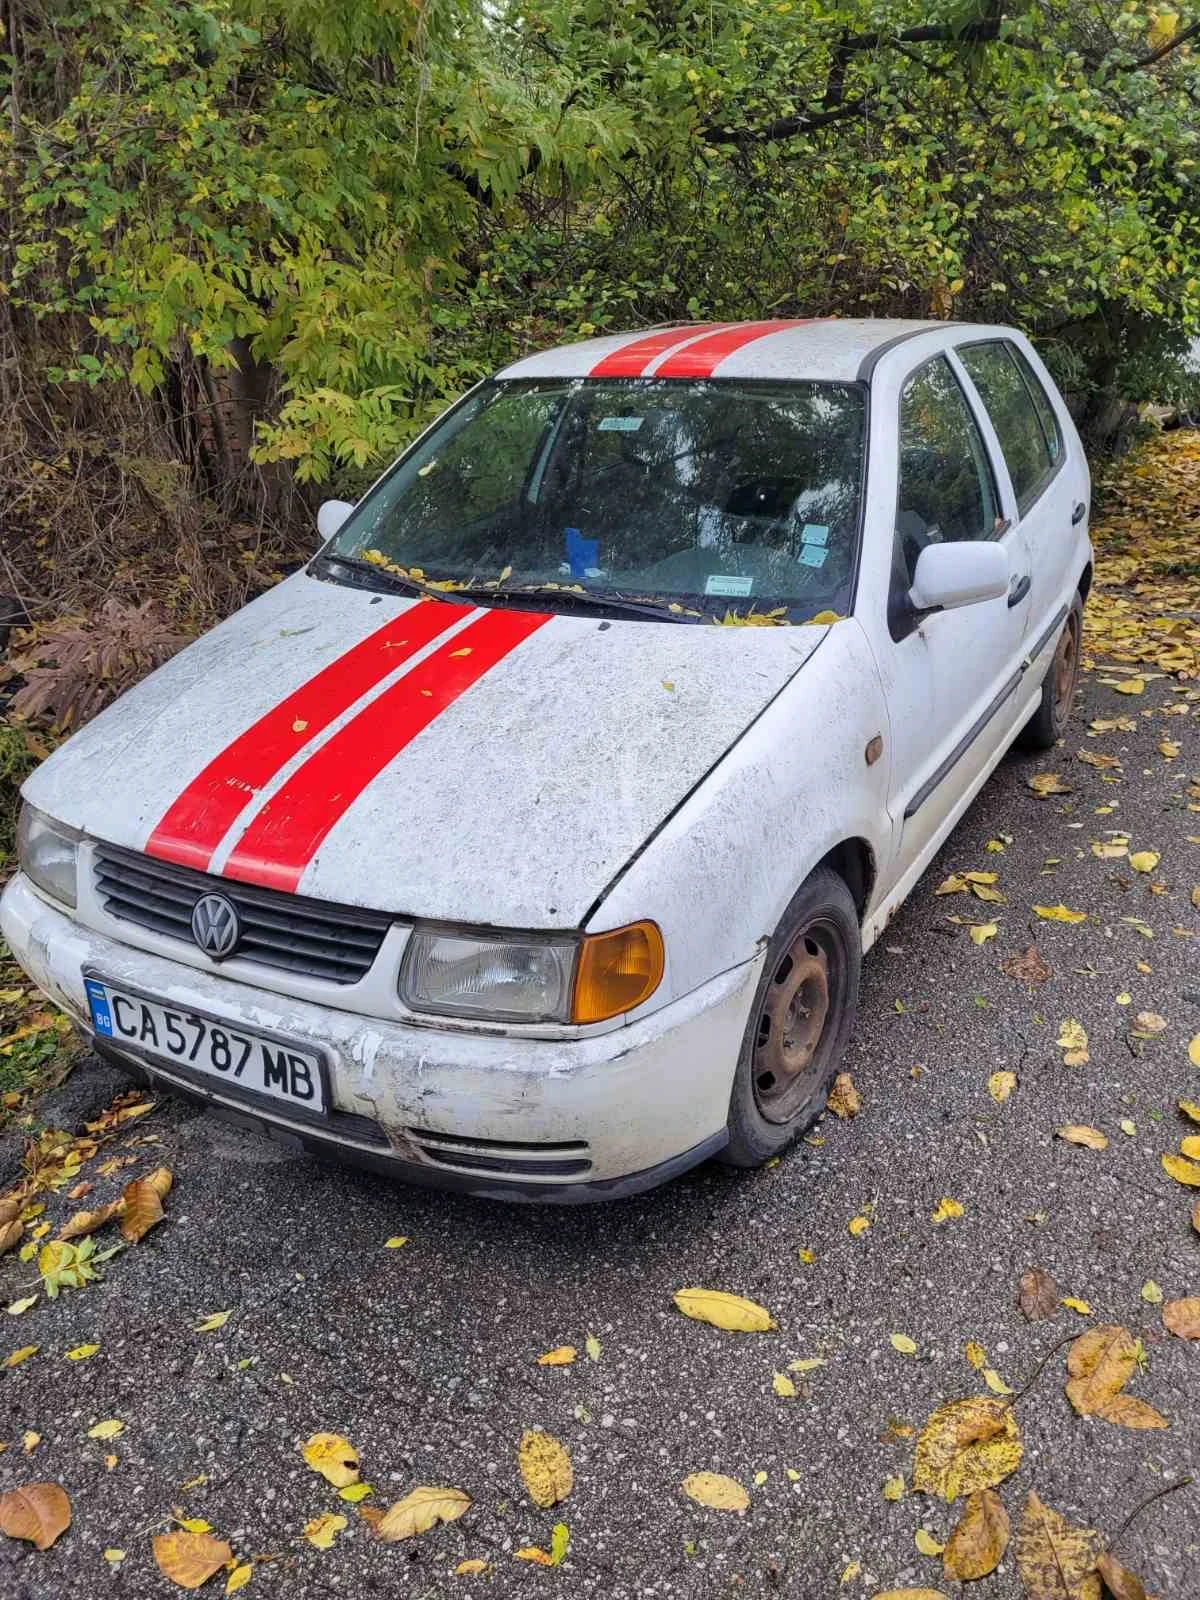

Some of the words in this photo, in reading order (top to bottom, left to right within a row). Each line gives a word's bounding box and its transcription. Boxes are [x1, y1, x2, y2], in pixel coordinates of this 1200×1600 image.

[193, 895, 237, 955] VW
[95, 1012, 112, 1028] BG
[112, 995, 159, 1047] CA
[163, 1011, 252, 1077] 5787
[261, 1044, 315, 1100] MB
